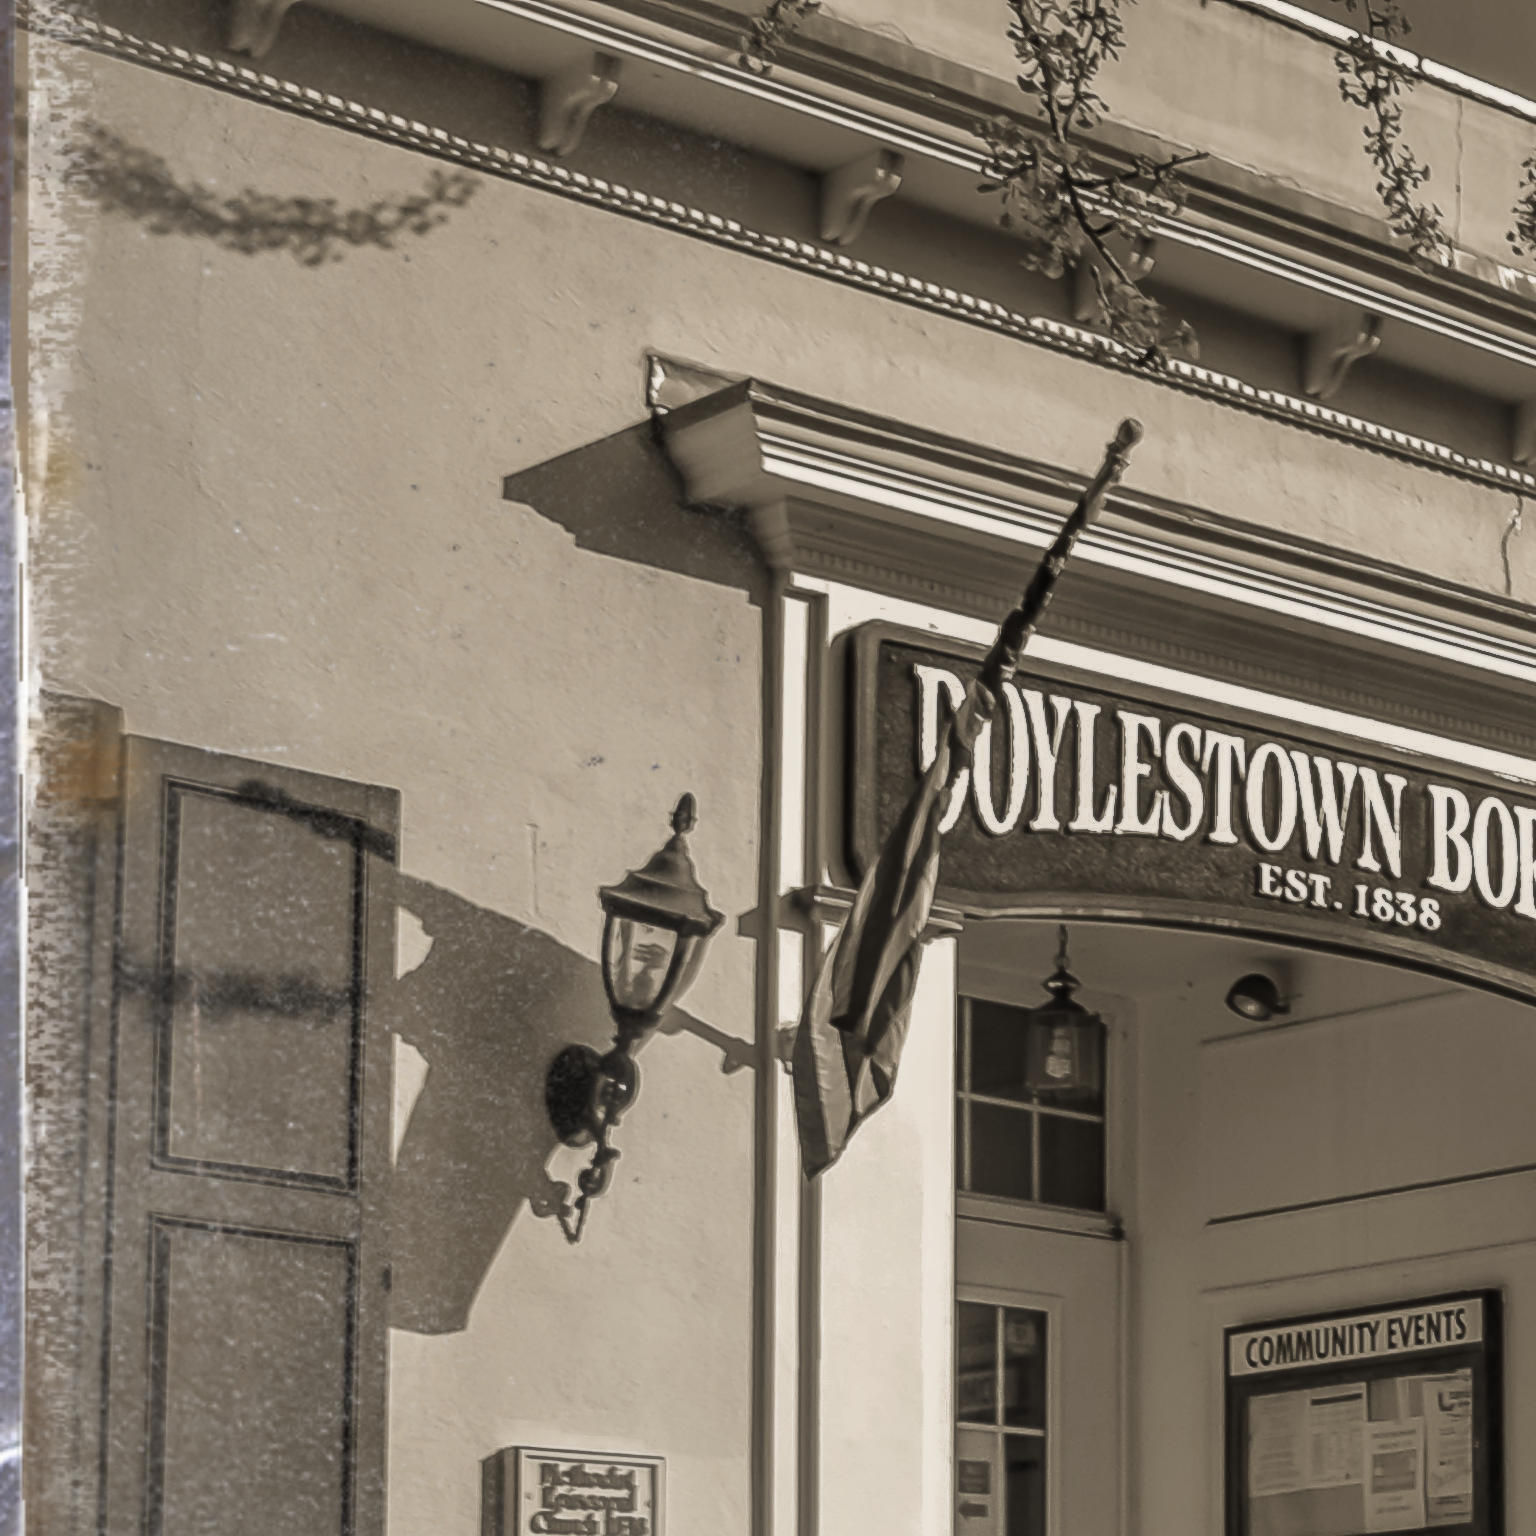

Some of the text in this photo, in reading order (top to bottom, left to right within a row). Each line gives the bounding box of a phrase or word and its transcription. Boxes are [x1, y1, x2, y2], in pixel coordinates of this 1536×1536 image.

[913, 663, 1408, 879] DOYLESTOWN
[1258, 862, 1442, 931] EST. 1838
[1245, 1307, 1467, 1369] COMMUNITY EVENTS
